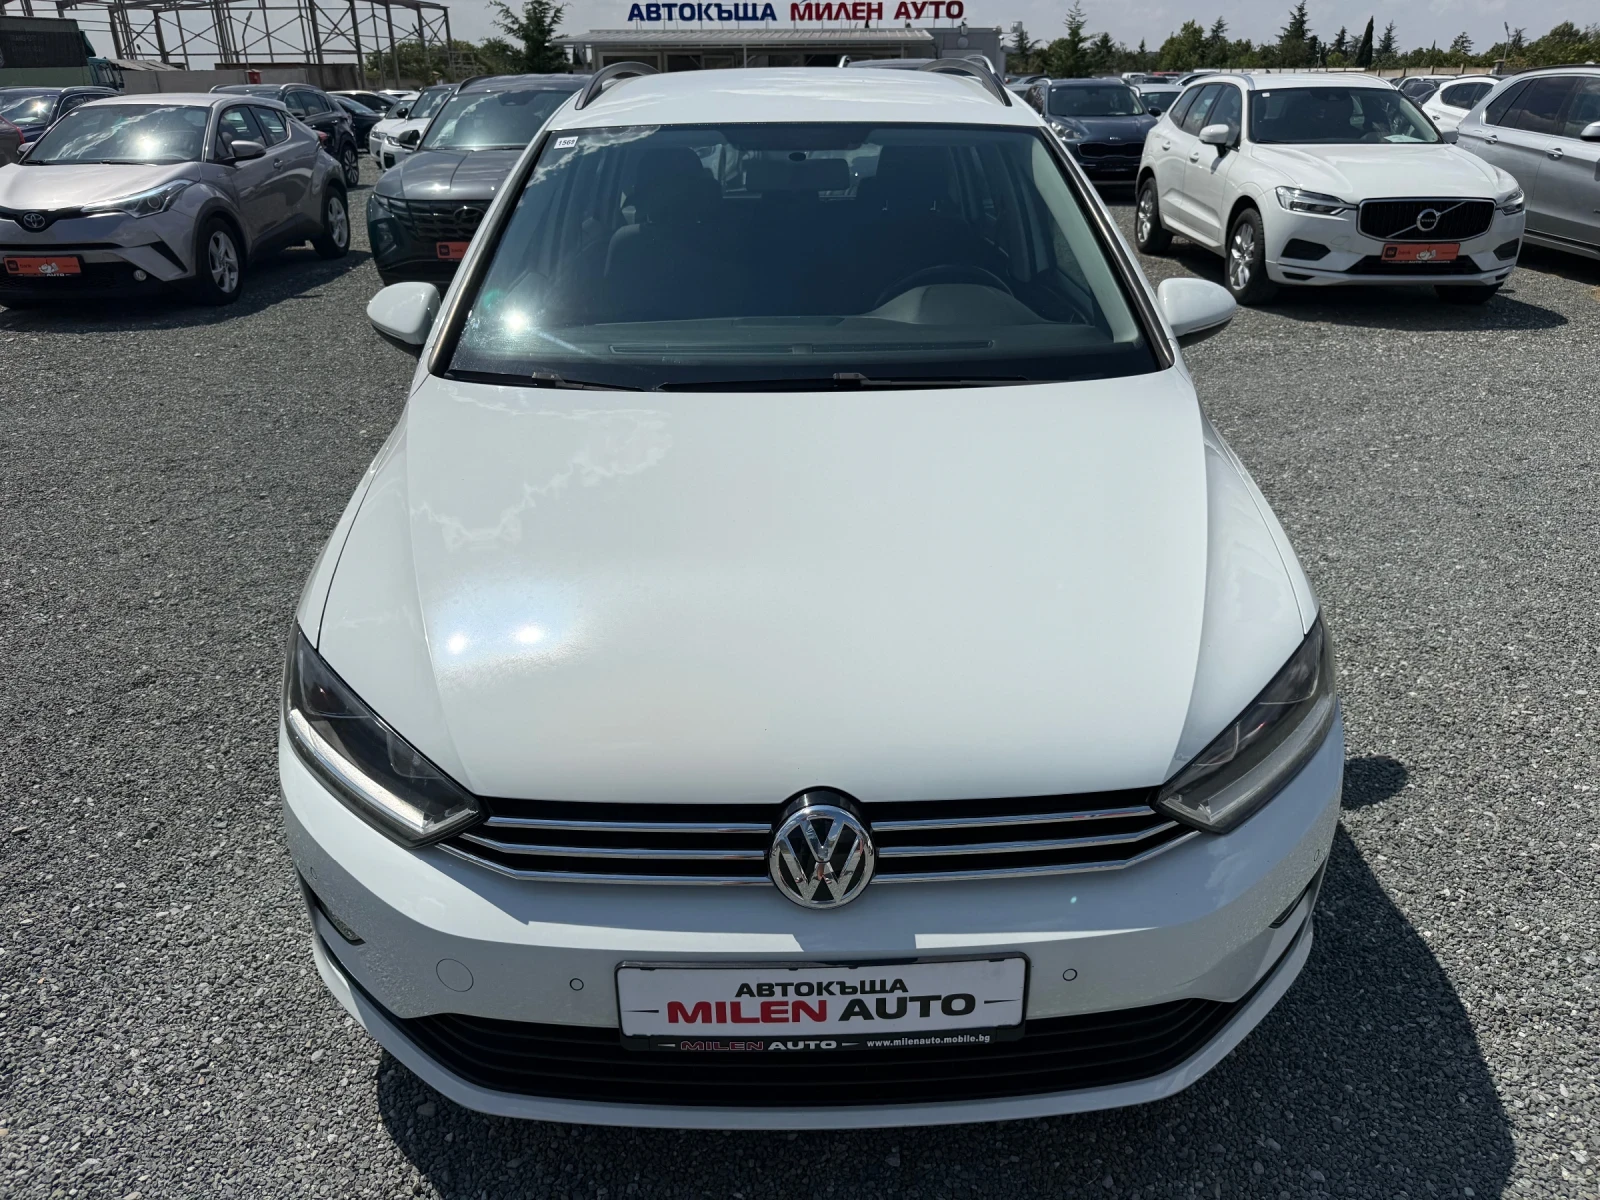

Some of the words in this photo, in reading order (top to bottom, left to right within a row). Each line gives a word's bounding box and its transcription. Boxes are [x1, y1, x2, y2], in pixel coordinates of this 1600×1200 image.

[627, 3, 778, 22] АВТОКЪЩА
[790, 2, 884, 22] МИЛЕН
[893, 1, 964, 20] АУТО
[735, 978, 909, 998] АВТОКЪЩА
[666, 1000, 828, 1024] MILEN
[837, 992, 977, 1022] AUTO
[680, 1040, 764, 1051] MILEN
[767, 1040, 838, 1050] AUTO
[866, 1034, 991, 1048] www.milenauto.mobile.bg
